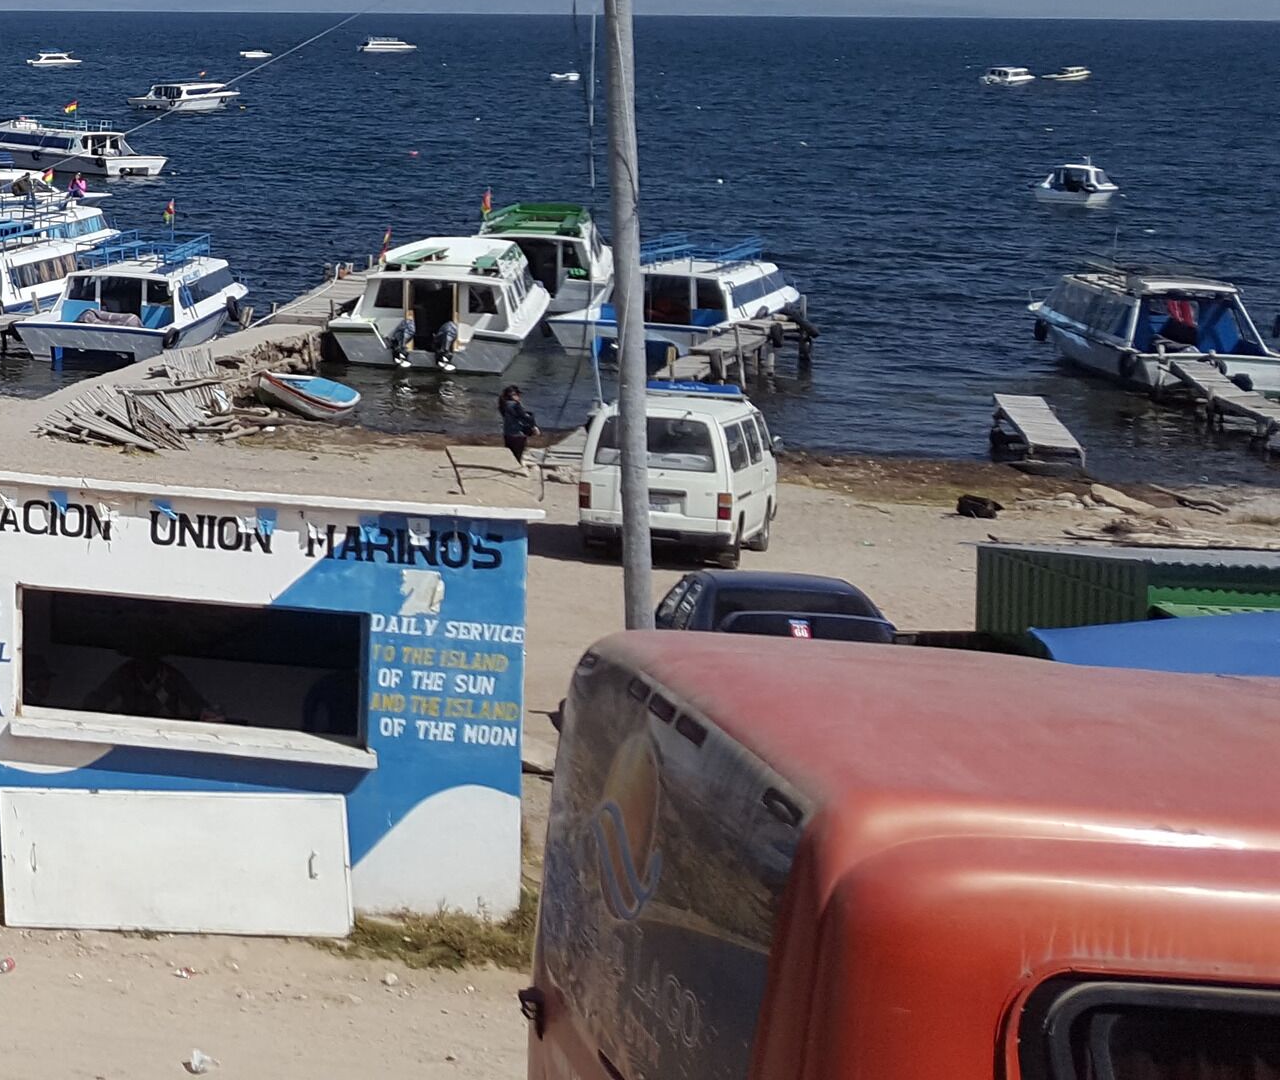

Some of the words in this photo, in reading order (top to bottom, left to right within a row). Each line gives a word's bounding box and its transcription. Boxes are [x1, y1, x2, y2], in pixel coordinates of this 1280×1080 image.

[149, 509, 273, 555] UNION
[303, 521, 504, 570] MARINOS
[371, 613, 439, 637] DAILY
[444, 620, 525, 644] SERVICE
[372, 643, 396, 662] TO
[402, 646, 436, 667] THE
[439, 650, 510, 673] ISLAND
[377, 667, 404, 689] OF
[411, 670, 446, 692] THE
[454, 674, 496, 696] SUN
[370, 692, 406, 713] AND
[410, 695, 442, 717] THE
[443, 697, 520, 722] ISLAND
[379, 716, 407, 738] OF
[416, 720, 457, 743] THE
[462, 723, 518, 747] MOON
